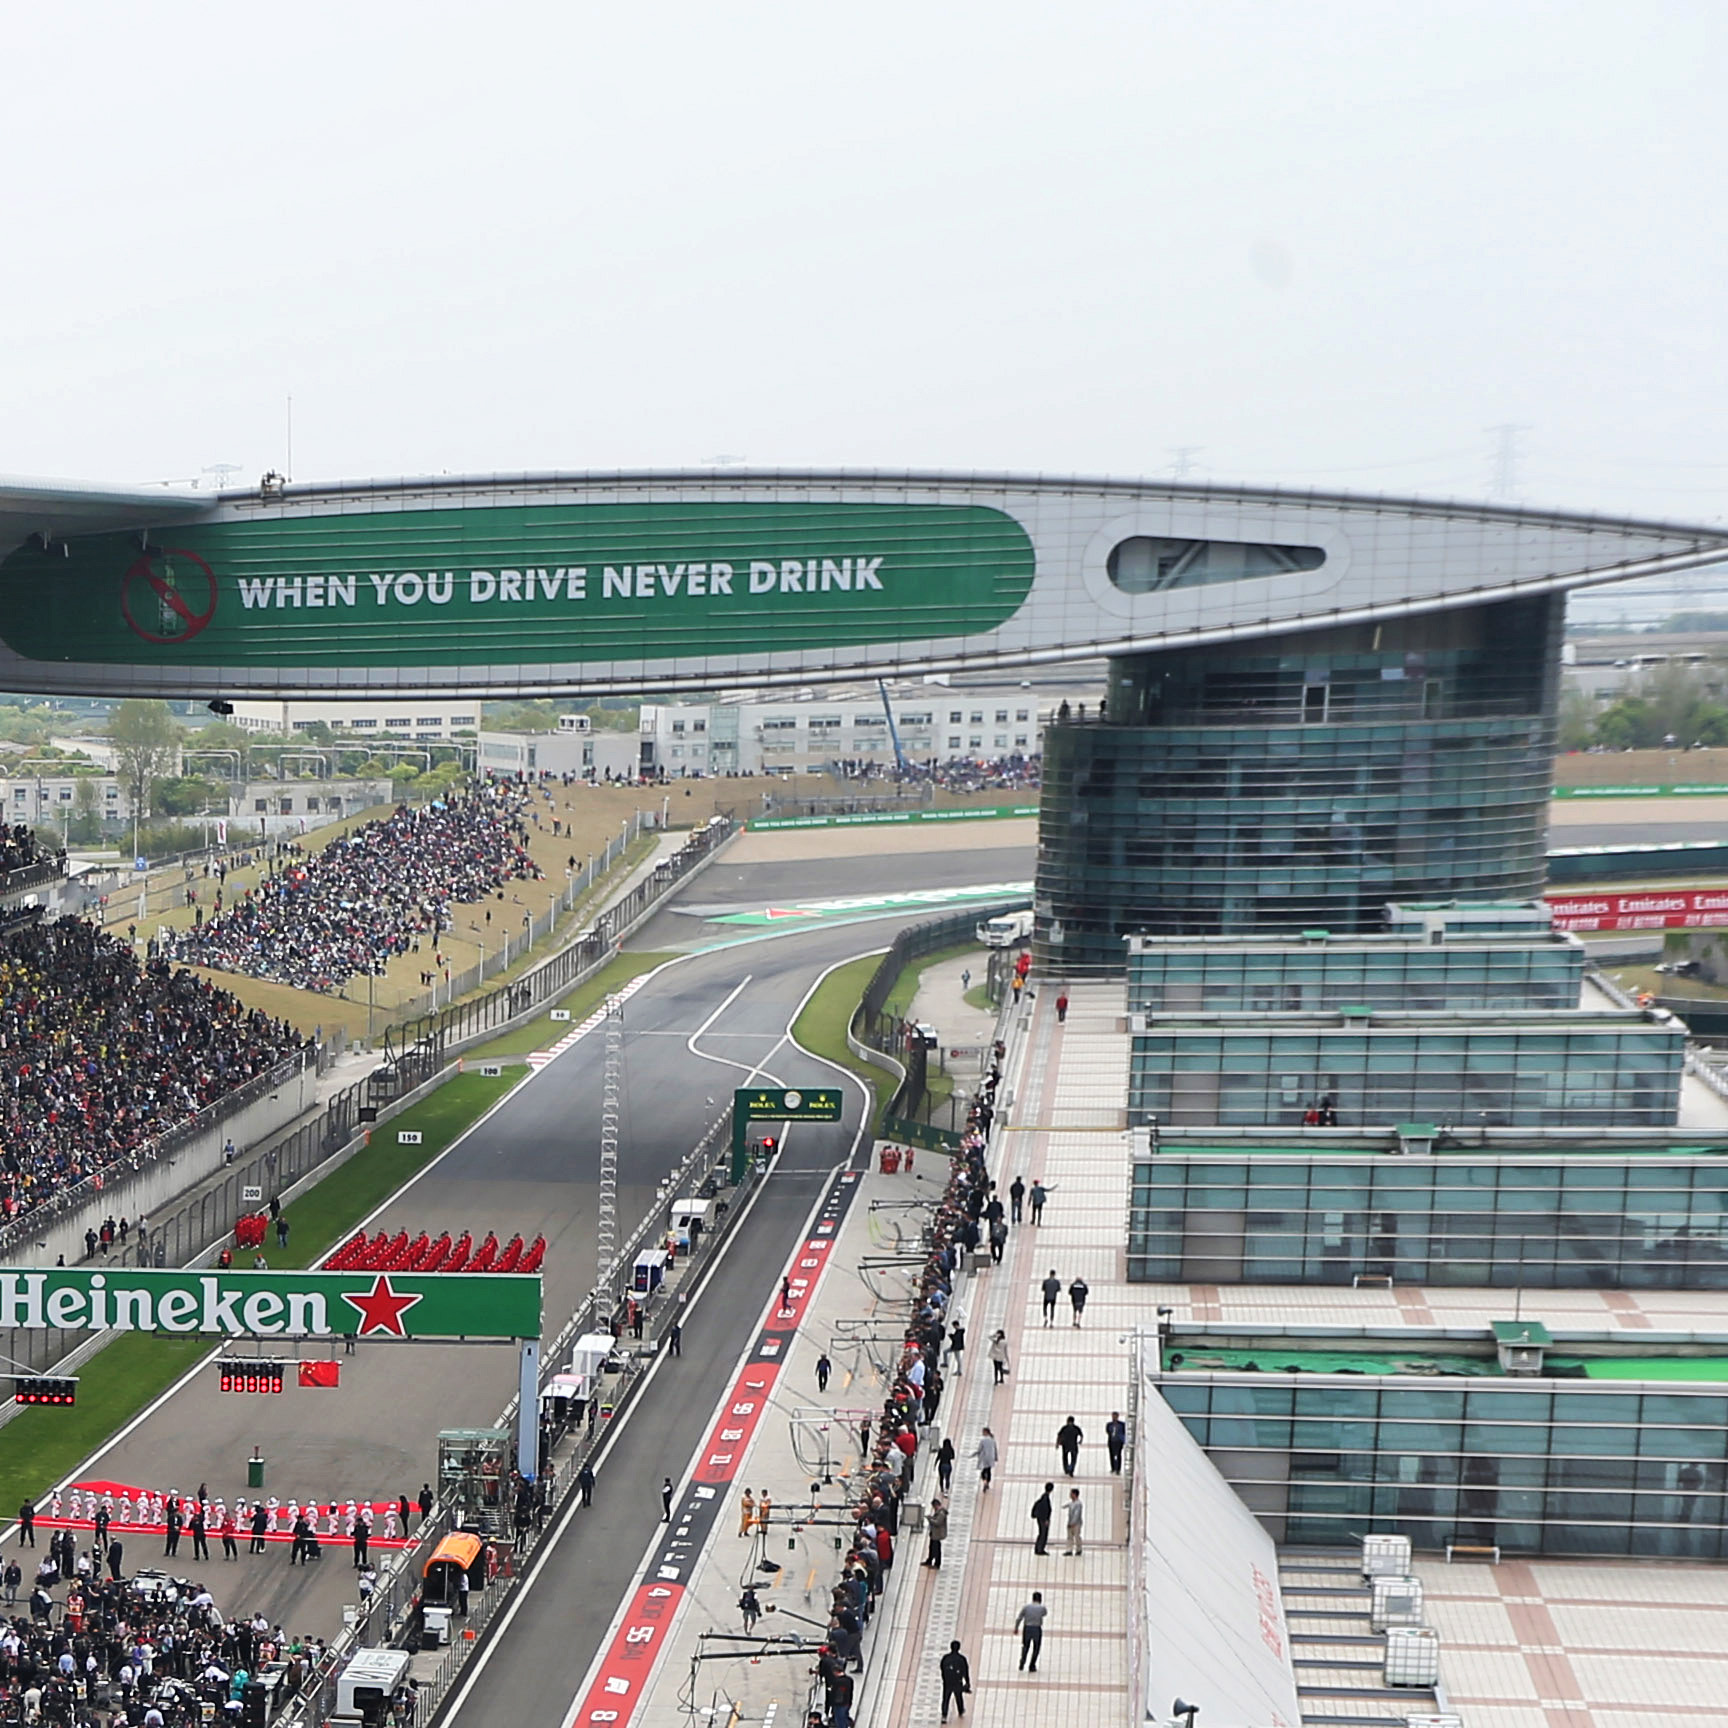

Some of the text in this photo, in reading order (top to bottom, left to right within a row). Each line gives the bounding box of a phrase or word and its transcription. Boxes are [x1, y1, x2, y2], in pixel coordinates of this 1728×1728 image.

[239, 556, 883, 609] WHEN YOU DRIVE NEVER DRINK
[484, 1066, 499, 1076] 100
[402, 1132, 418, 1142] 150
[245, 1187, 260, 1199] 200
[648, 1587, 672, 1598] 4
[626, 1625, 655, 1643] 55
[590, 1710, 618, 1721] 8
